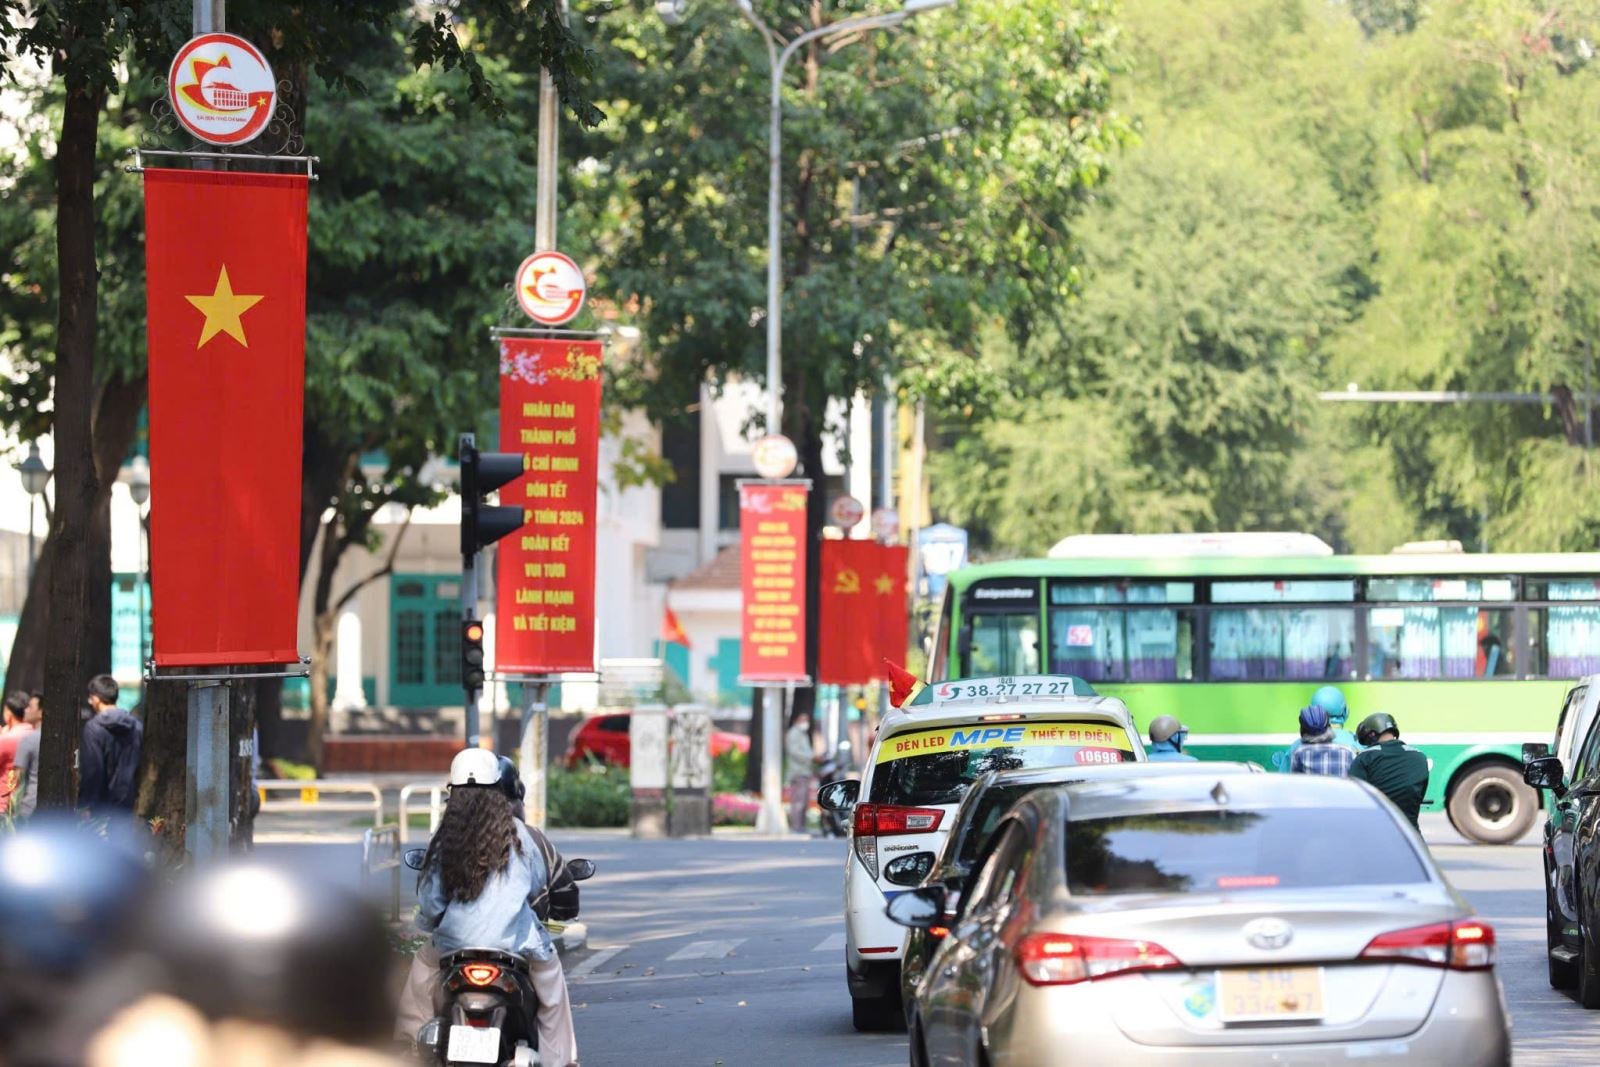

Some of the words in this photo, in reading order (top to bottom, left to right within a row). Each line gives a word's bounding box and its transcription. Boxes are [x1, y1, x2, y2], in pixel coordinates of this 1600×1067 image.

[523, 400, 552, 417] NHÂN
[553, 400, 575, 418] DÂN
[520, 427, 554, 445] THÀNH
[555, 427, 576, 445] PHỐ
[532, 454, 550, 471] CHÍ
[551, 457, 579, 472] MINH
[549, 480, 567, 498] TẾT
[559, 510, 584, 525] 2024
[550, 533, 570, 552] KẾT
[524, 563, 542, 577] VUI
[515, 587, 543, 605] LÀNH
[544, 590, 574, 608] MẠNH
[513, 614, 528, 631] VÀ
[528, 613, 549, 631] TIẾT
[550, 614, 577, 634] KIỆM
[967, 684, 1017, 697] 38.27
[1022, 683, 1043, 695] 27
[1049, 682, 1070, 694] 27
[896, 738, 919, 752] ĐÈN
[923, 736, 945, 748] LED
[950, 728, 1026, 747] MPE
[1031, 726, 1065, 740] THIẾT
[1069, 730, 1081, 742] BỊ
[1084, 729, 1113, 743] ĐIỆN
[1079, 750, 1118, 764] 10698
